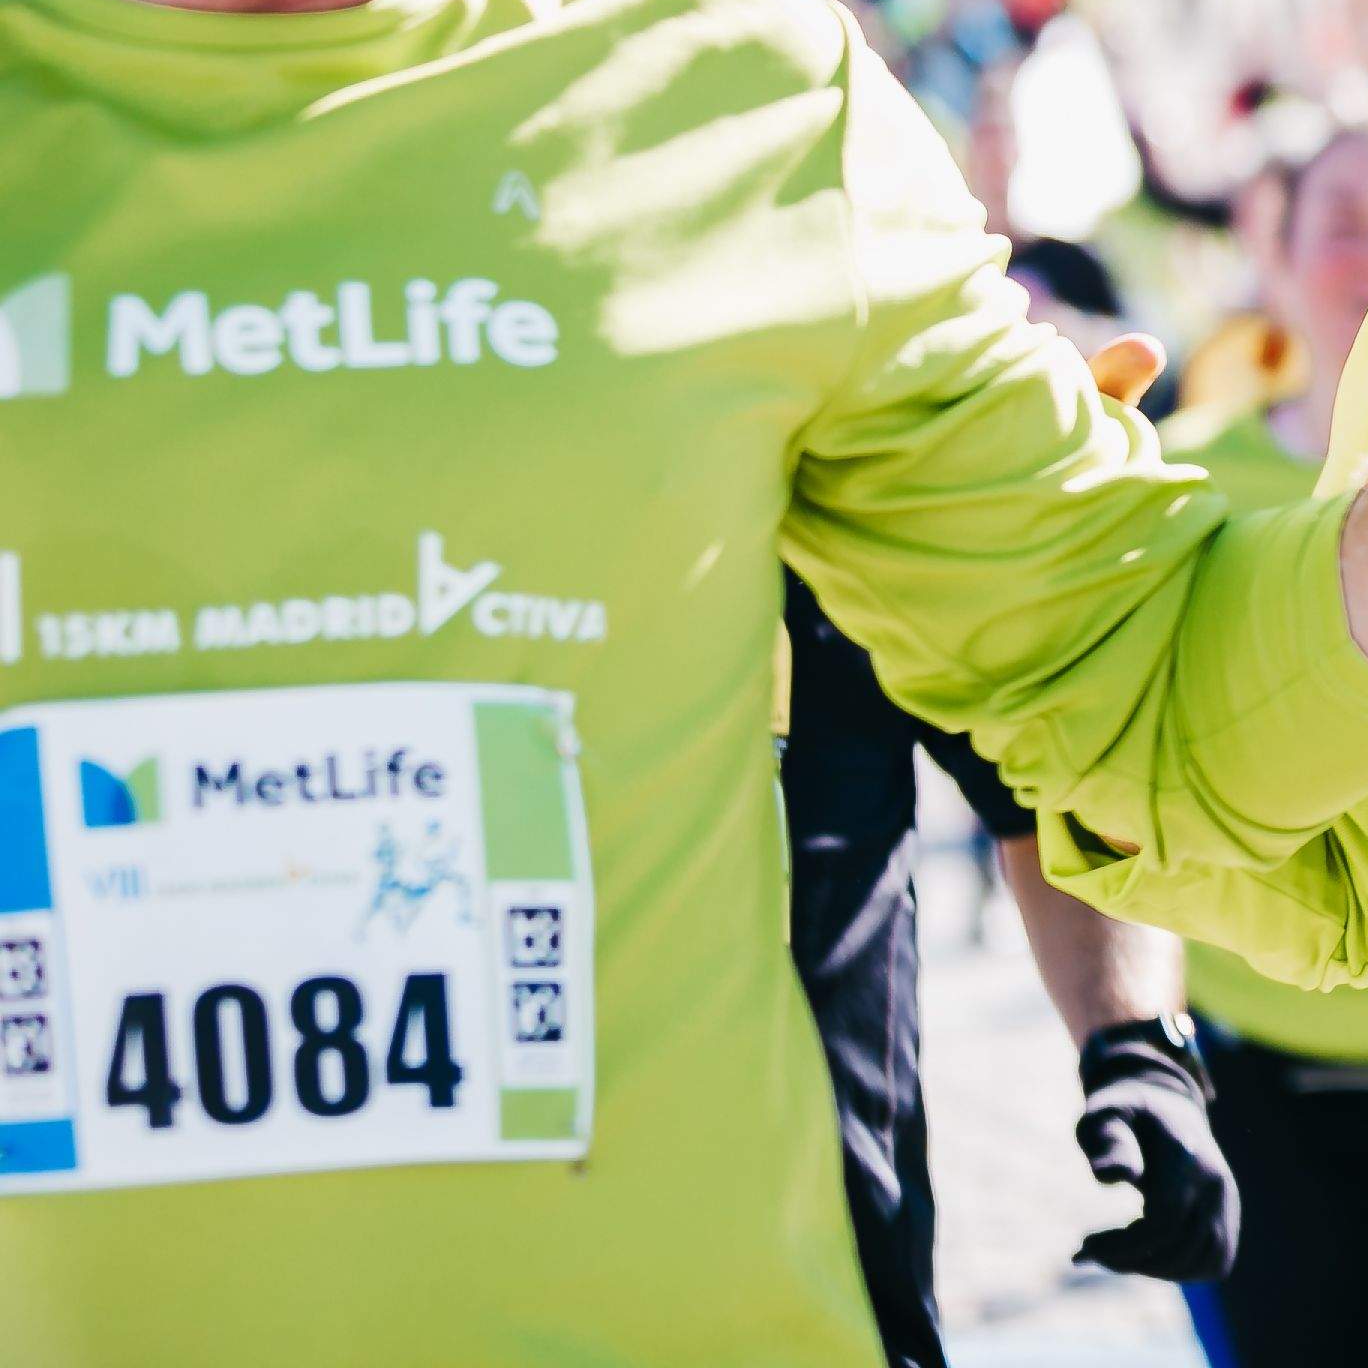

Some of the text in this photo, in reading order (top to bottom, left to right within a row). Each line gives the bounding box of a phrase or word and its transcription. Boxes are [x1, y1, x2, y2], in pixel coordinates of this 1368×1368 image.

[106, 278, 560, 378] MetLife
[192, 748, 446, 810] MetLife
[106, 973, 464, 1129] 4084
